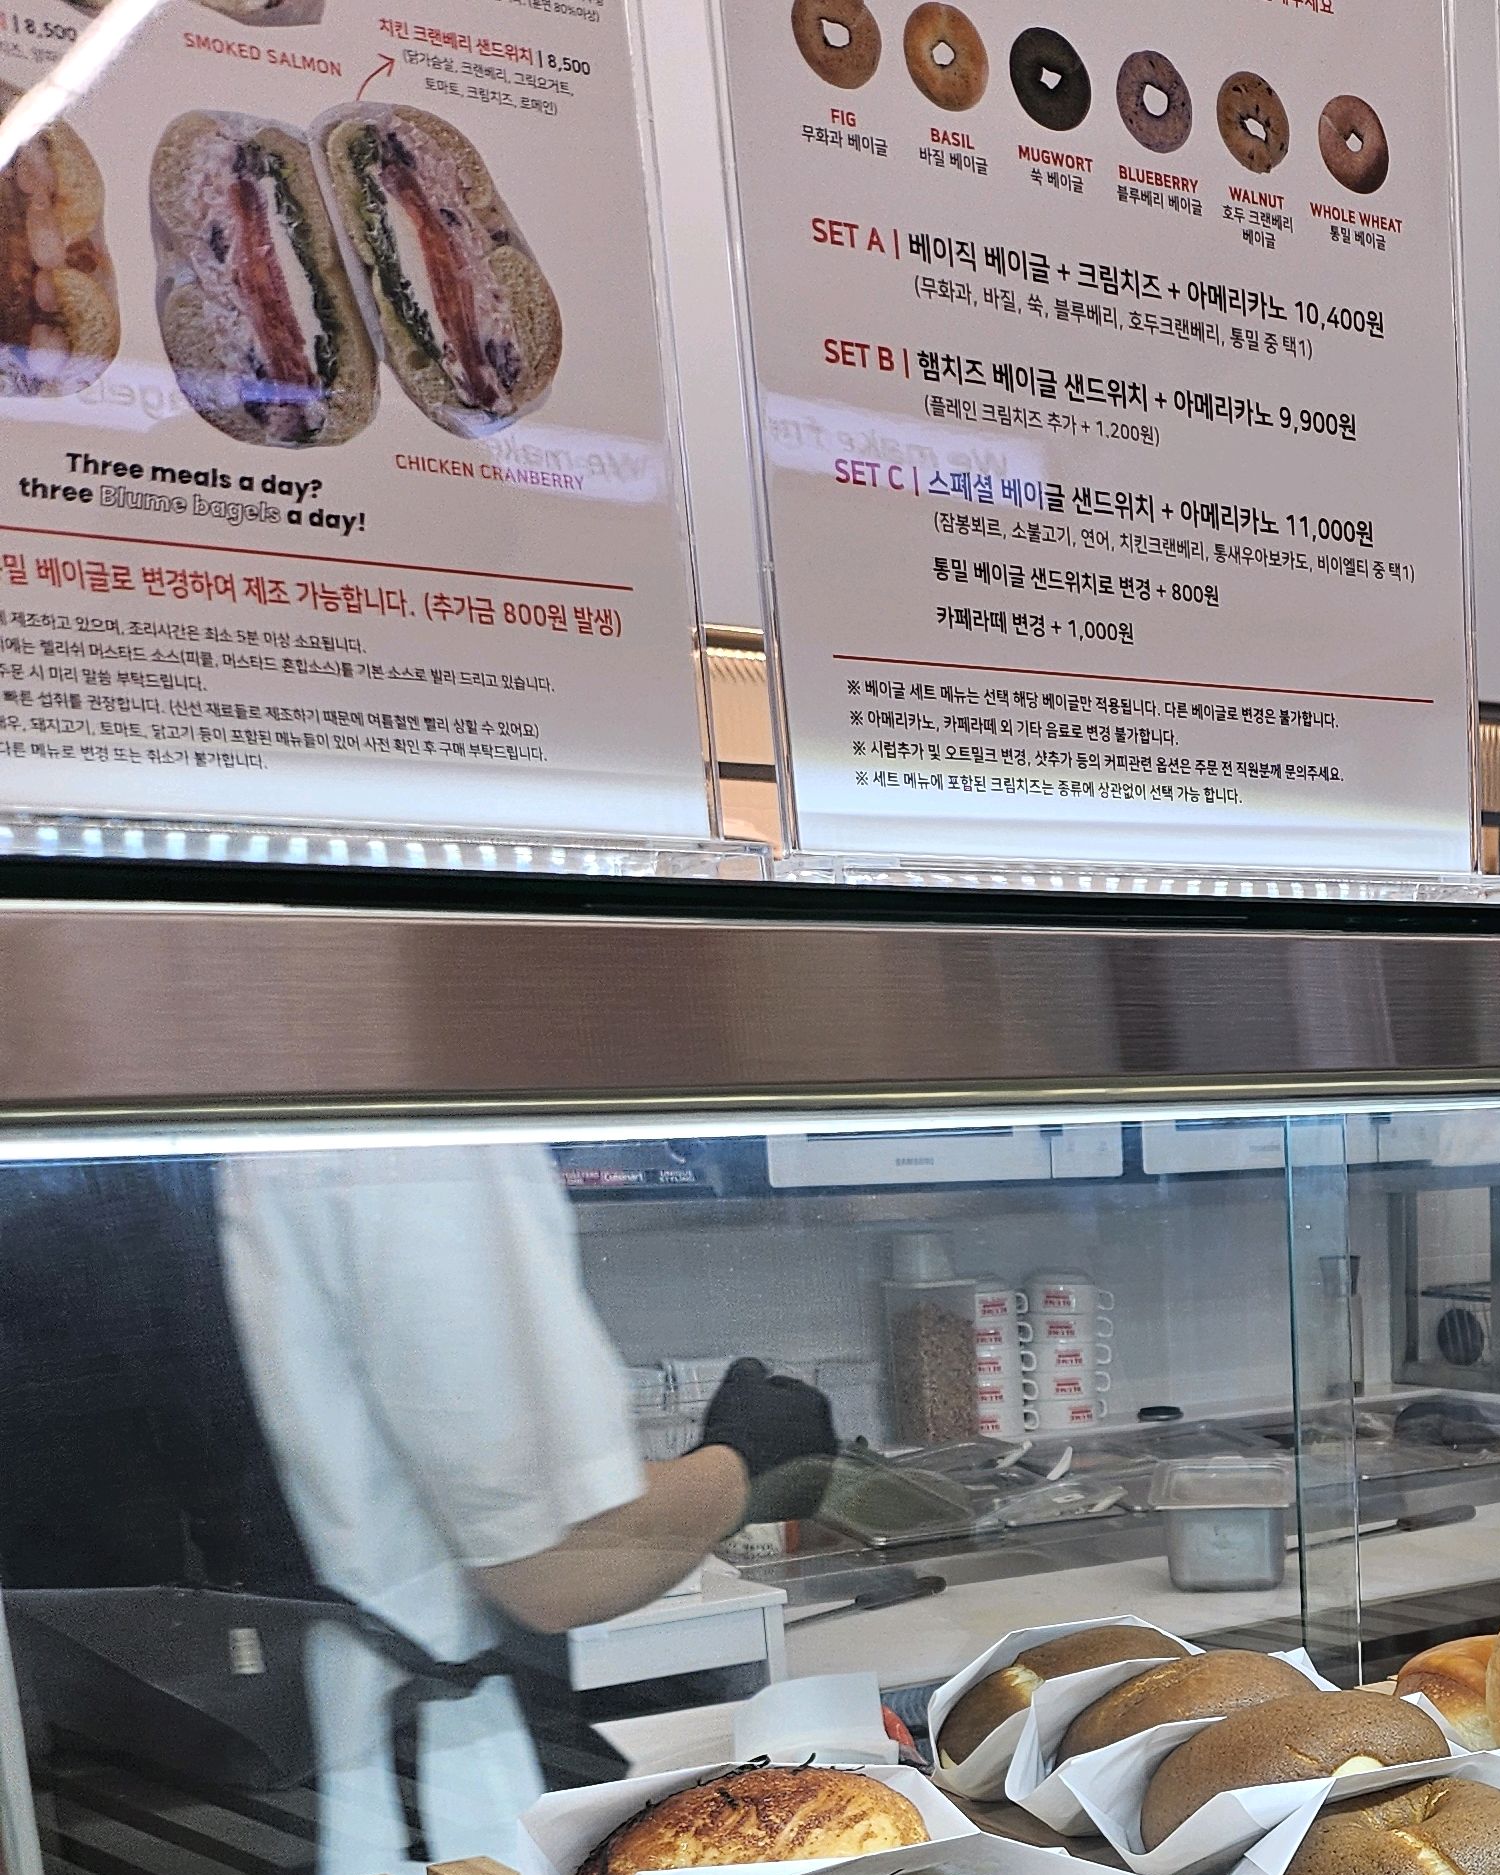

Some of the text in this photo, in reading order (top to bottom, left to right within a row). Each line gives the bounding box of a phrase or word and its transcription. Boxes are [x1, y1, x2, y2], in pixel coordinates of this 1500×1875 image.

[184, 32, 342, 77] SMOKED SALMON
[379, 18, 590, 76] 치킨 크랜베리 샌드위치 8,500
[830, 108, 856, 127] FIG
[930, 128, 974, 150] BASIL
[1018, 145, 1093, 172] MUGWORT
[1118, 165, 1198, 193] BLUEBERRY
[1229, 186, 1284, 210] WALNUT
[1310, 202, 1402, 233] WHOLE WHEAT
[812, 218, 1385, 339] SET A 베이직 베이글 크림치즈 아메리카노 10,400원
[824, 338, 1356, 441] SET B 햄치즈 베이글 샌드위치 아메리카노 9,900원
[66, 452, 322, 503] Three meals a day?
[395, 454, 474, 479] CHICKEN
[480, 463, 585, 491] CRANBERRY
[19, 477, 366, 536] three Blume bagels a day!
[835, 458, 1374, 548] SET C 스페셜 베이글 샌드위치 아메리카노 11,000원
[35, 556, 136, 593] 베이글로
[141, 565, 237, 603] 변경하여
[242, 577, 290, 606] 제조
[297, 581, 416, 618] 가능합니다.
[424, 592, 496, 626] (추가금
[504, 602, 567, 632] 800원
[573, 605, 623, 638] 발생)
[865, 680, 1339, 728] 베이글 세트 메뉴는 선택 해당 베이글만 적용됩니다. 다른 베이글로 변경은 불가합니다.
